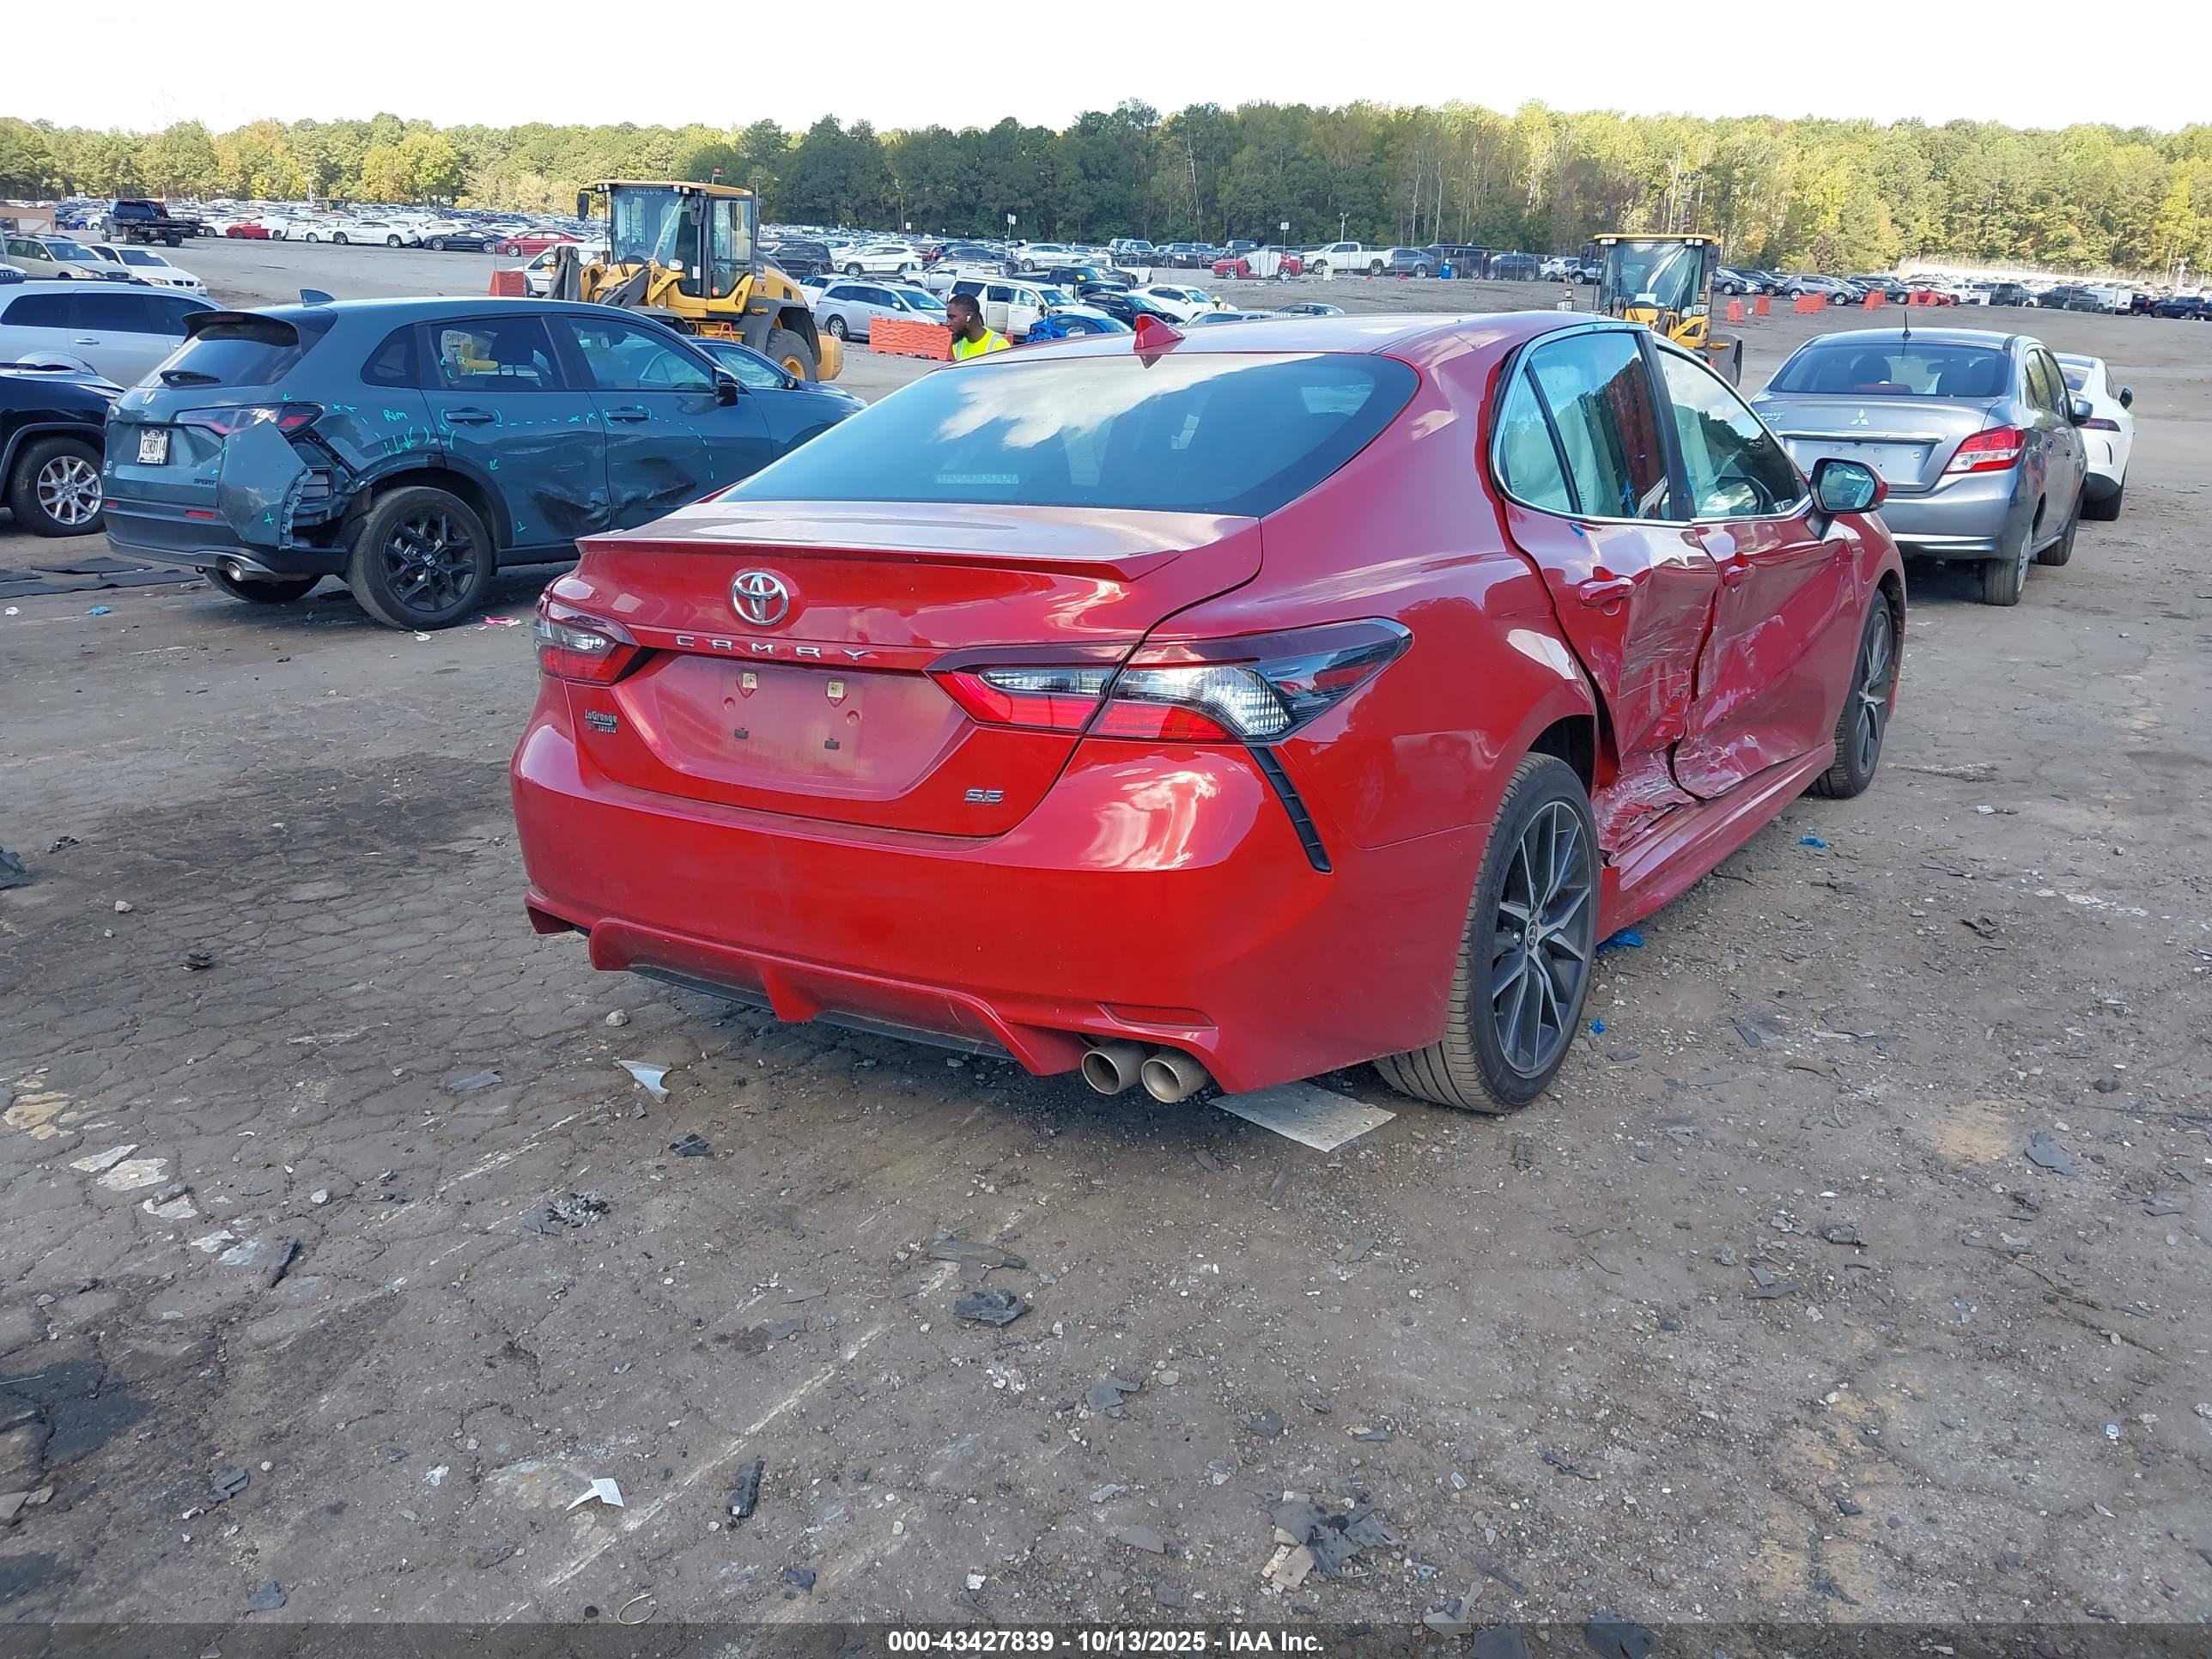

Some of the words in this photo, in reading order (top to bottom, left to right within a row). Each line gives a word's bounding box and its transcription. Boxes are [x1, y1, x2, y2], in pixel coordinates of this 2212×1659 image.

[675, 634, 872, 661] CAMRY
[585, 708, 618, 726] LaGrange
[598, 725, 617, 734] TOYOTA
[963, 788, 1005, 805] SE
